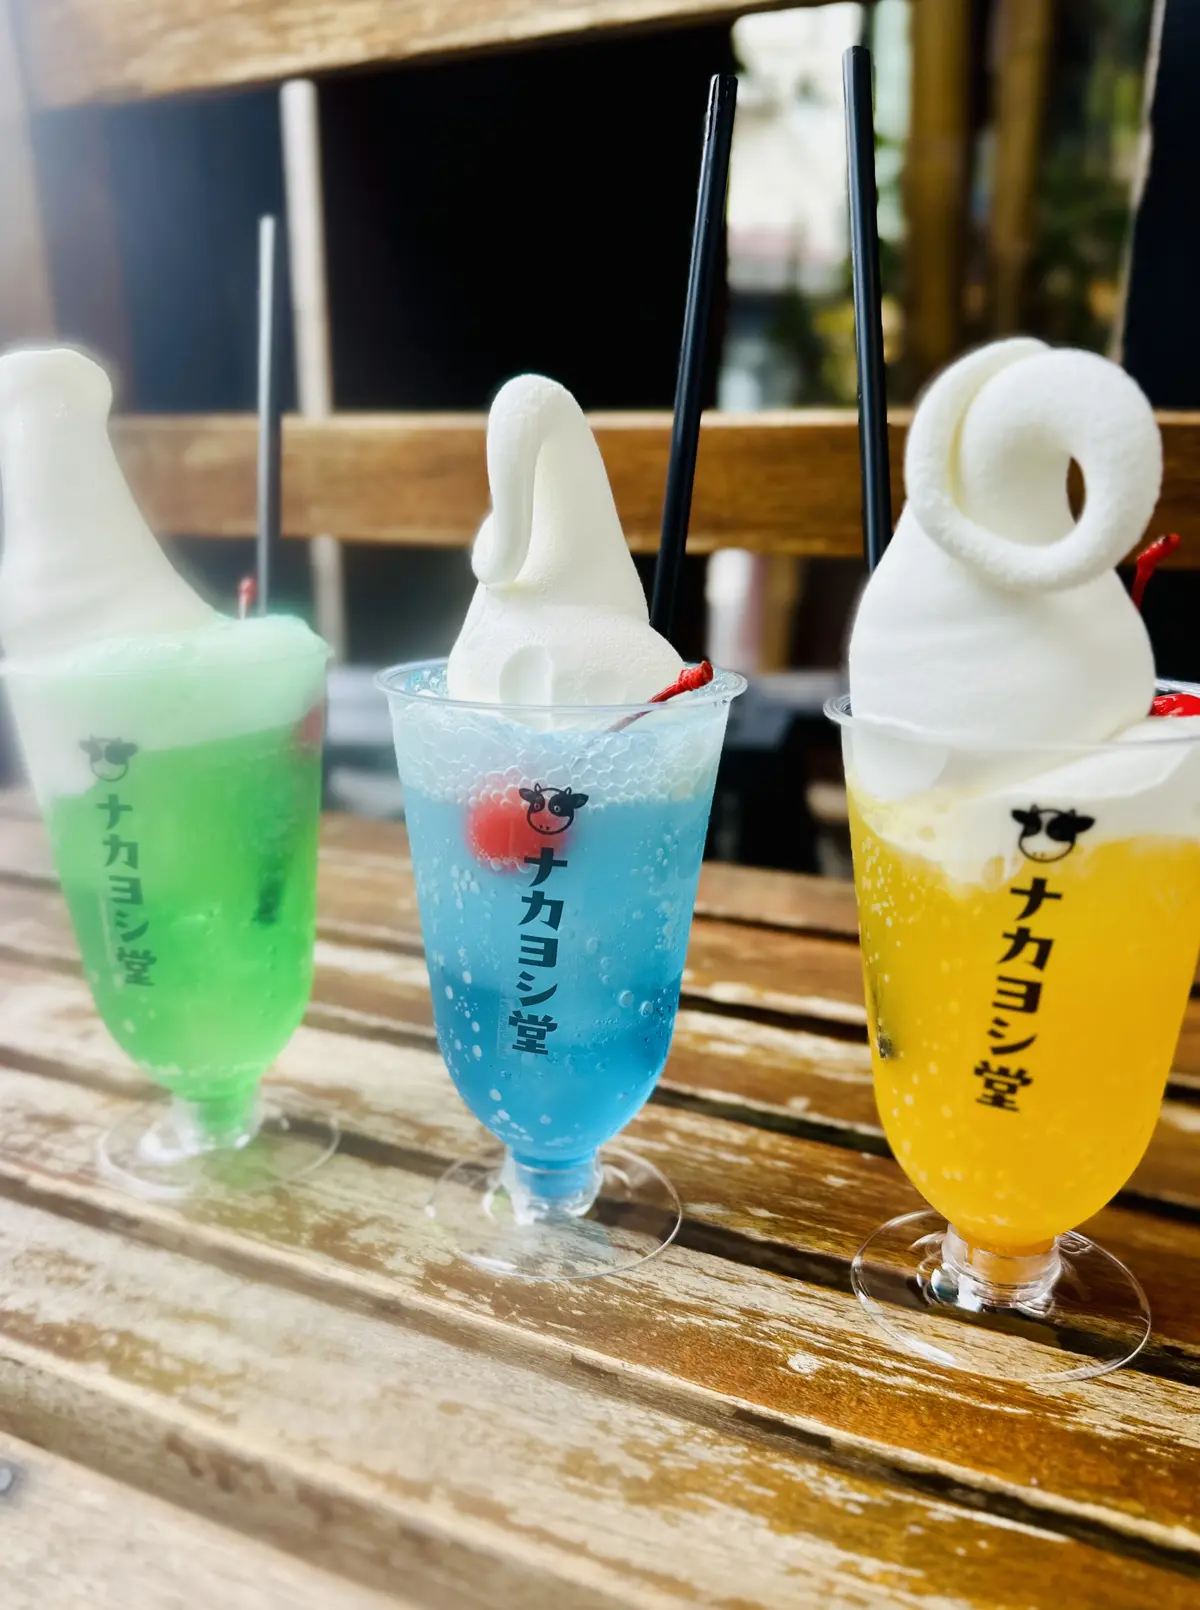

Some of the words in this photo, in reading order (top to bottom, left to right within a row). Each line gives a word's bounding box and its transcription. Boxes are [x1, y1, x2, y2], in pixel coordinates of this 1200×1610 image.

[96, 793, 158, 987] ナカヨシ堂
[508, 847, 568, 1055] ナカヨシ堂
[973, 876, 1063, 1113] ナカヨシ堂
